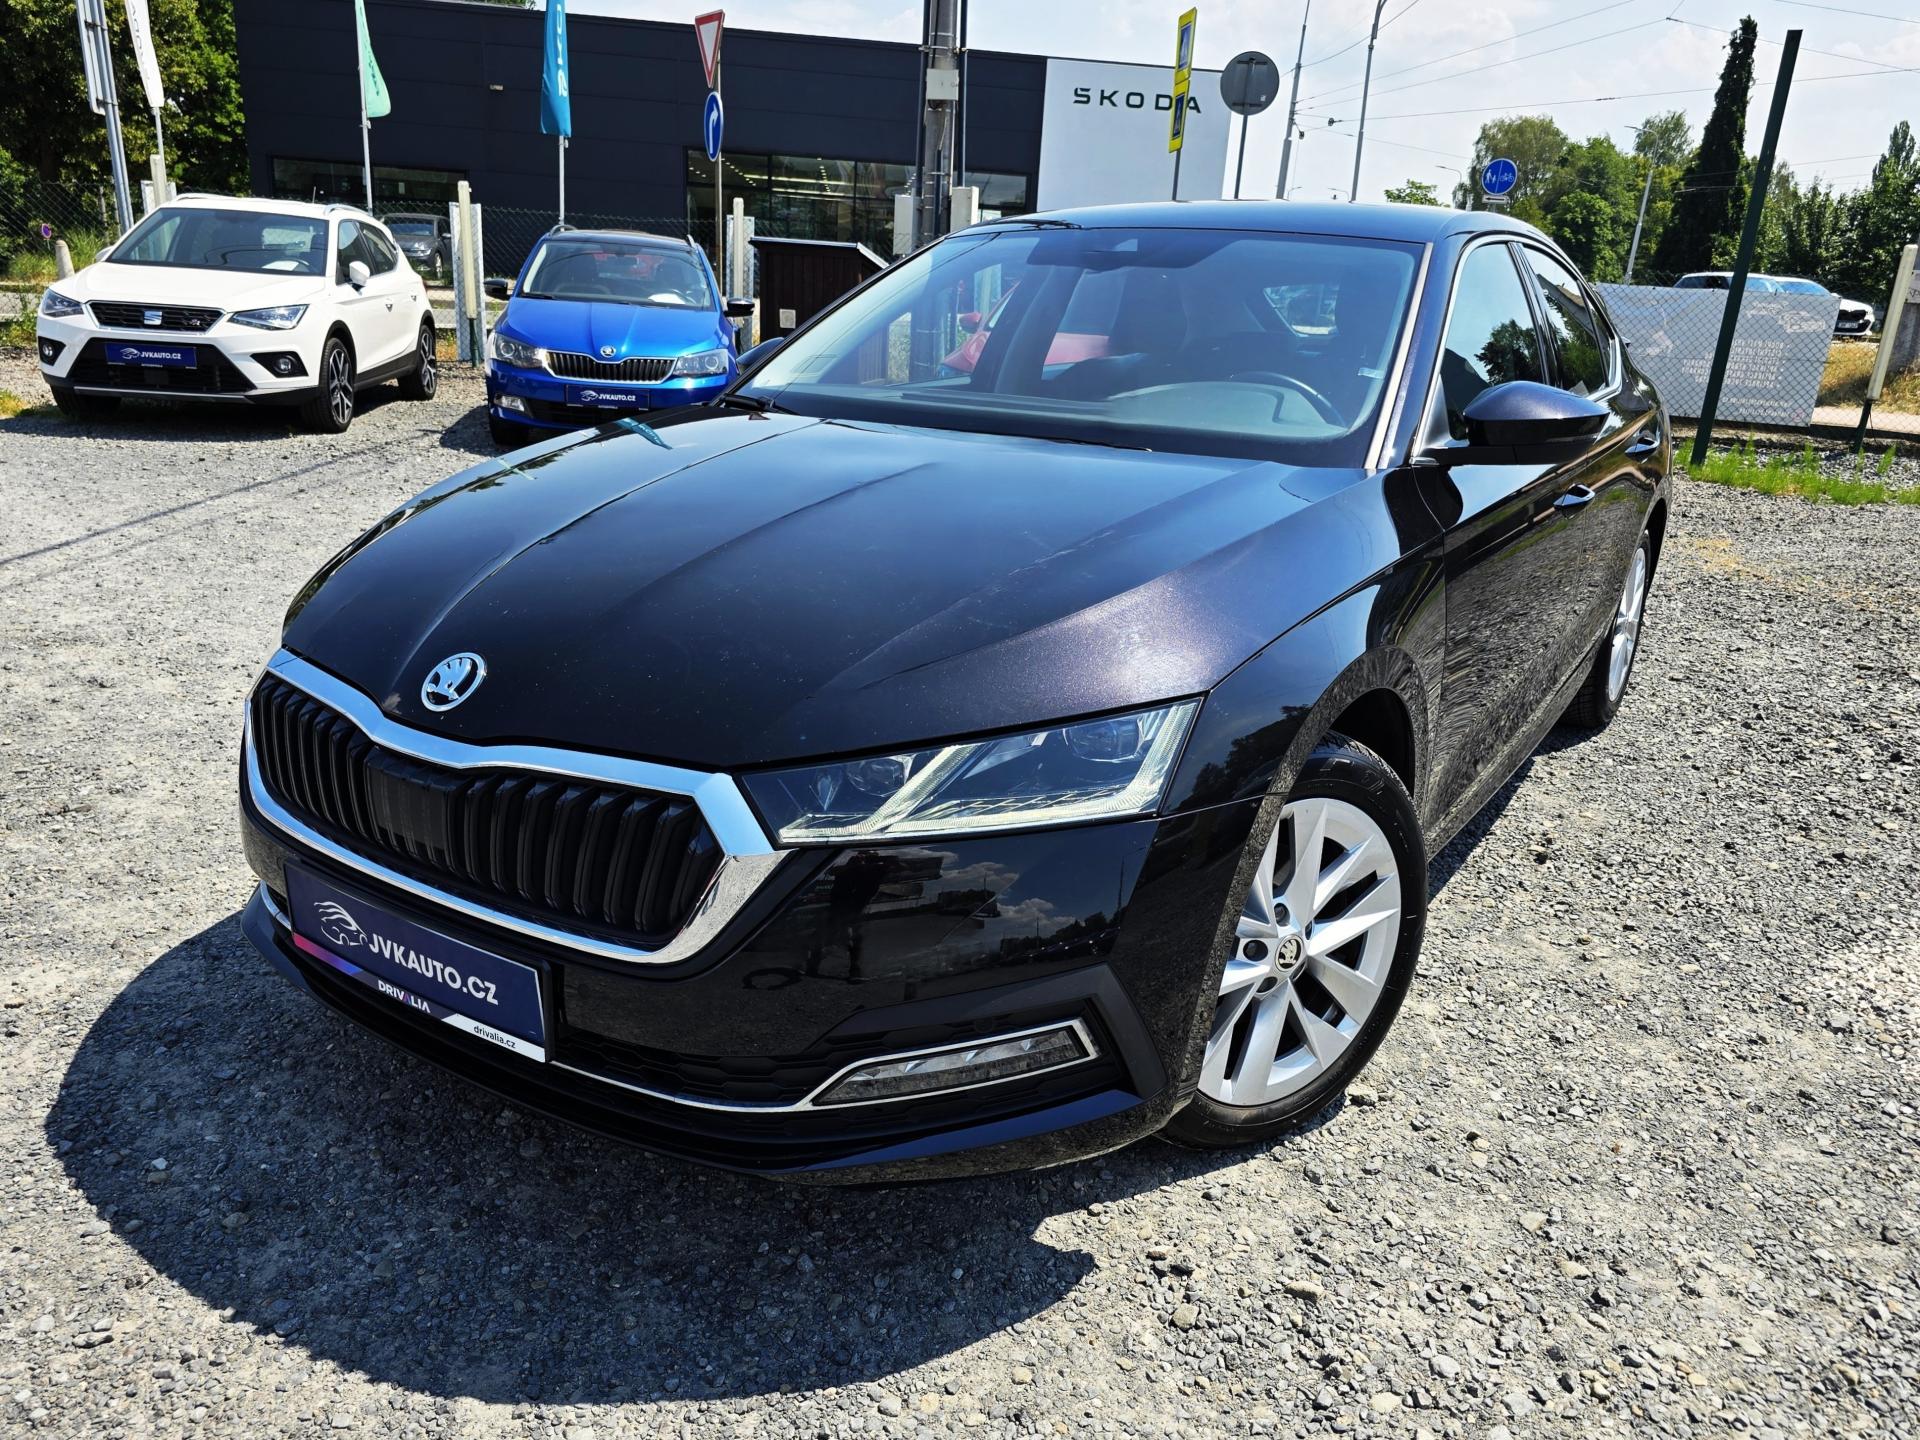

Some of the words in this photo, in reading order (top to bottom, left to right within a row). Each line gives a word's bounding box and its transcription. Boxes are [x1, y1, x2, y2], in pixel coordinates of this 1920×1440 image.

[140, 351, 182, 360] JVKAUTO.CZ
[598, 393, 637, 402] JVKAUTO.CZ
[368, 932, 499, 1006] JVKAUTO.CZ
[377, 979, 431, 1014] DRIVALIA
[473, 1024, 517, 1049] drivalia.cz
